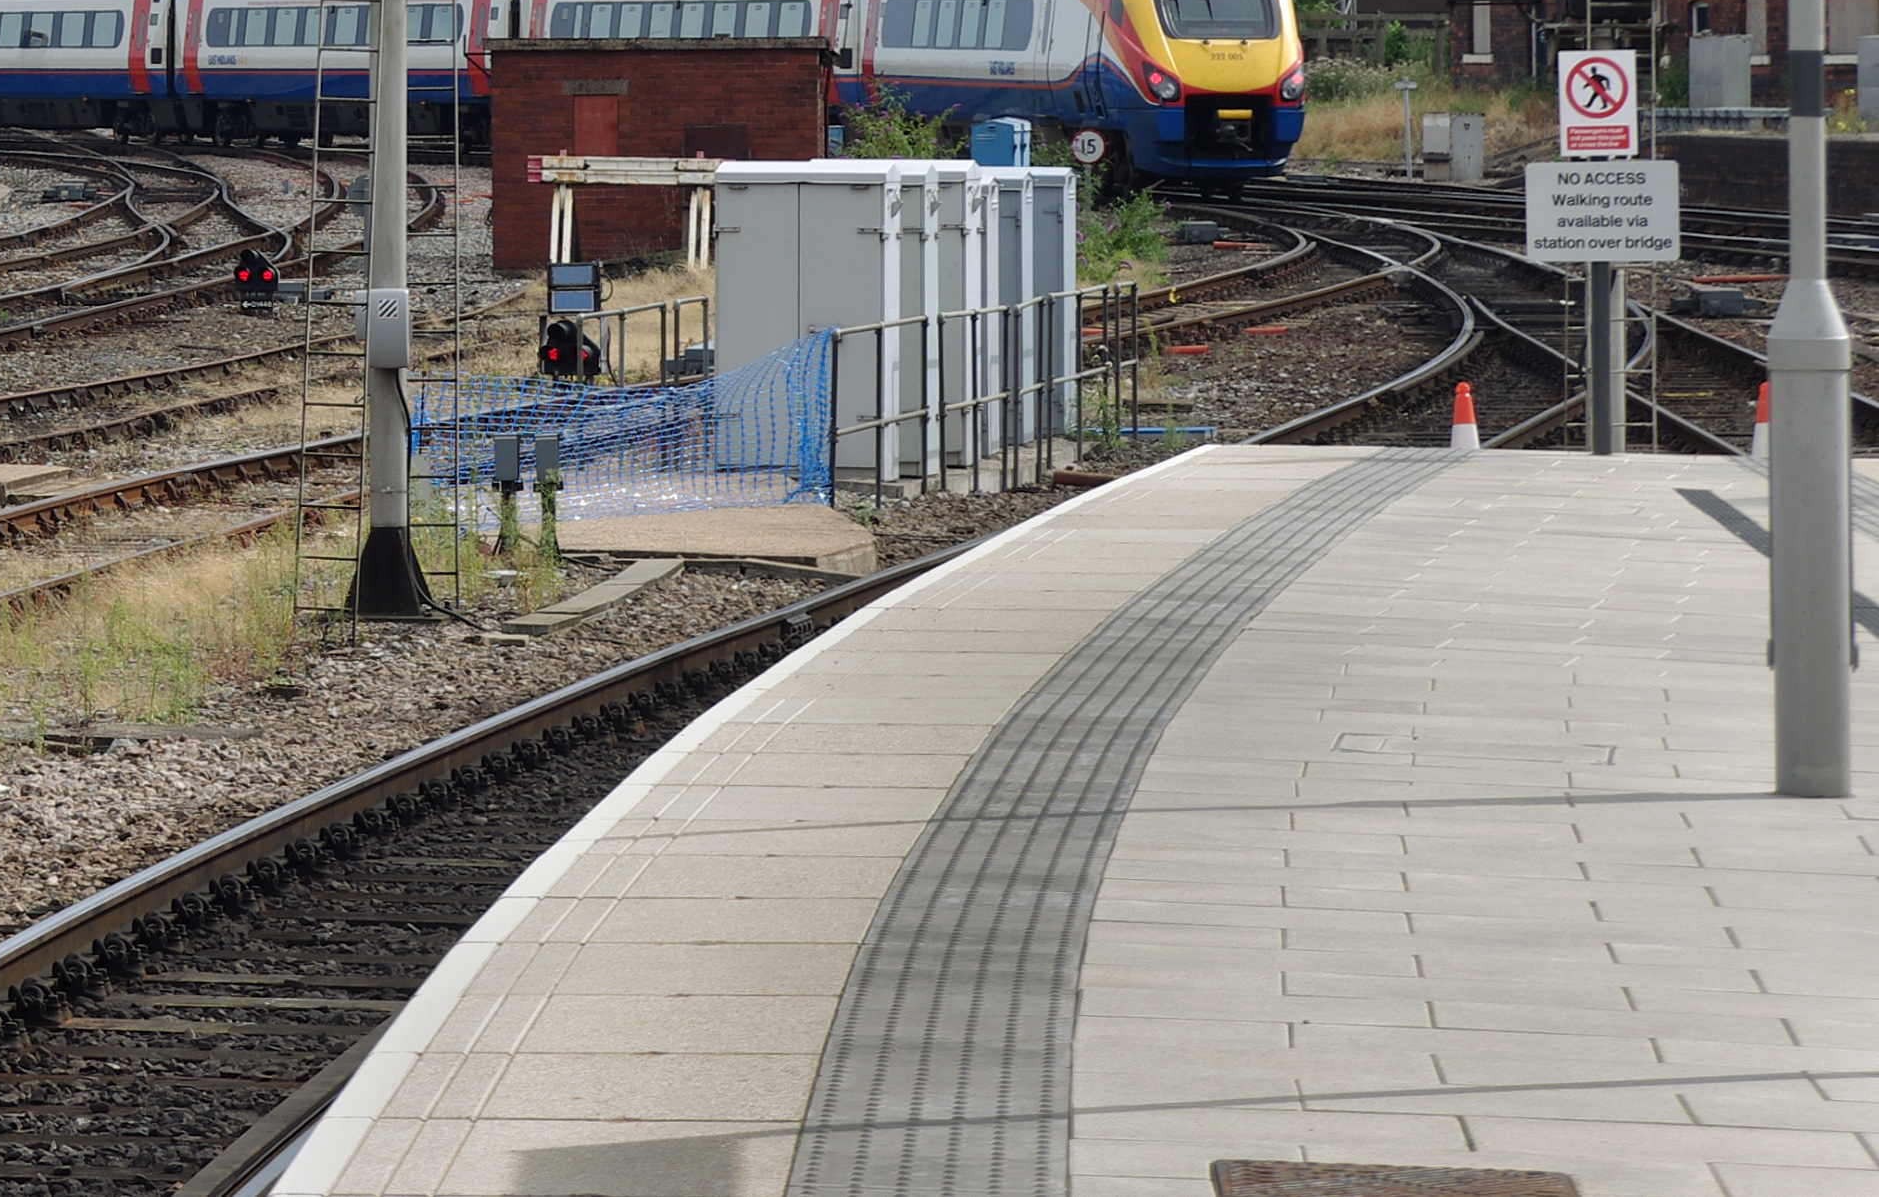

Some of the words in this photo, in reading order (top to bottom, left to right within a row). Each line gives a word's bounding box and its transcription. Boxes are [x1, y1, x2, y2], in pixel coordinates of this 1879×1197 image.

[1081, 139, 1096, 154] 15
[1557, 172, 1581, 185] NO
[1584, 172, 1646, 185] ACCESS
[1552, 194, 1610, 208] Walking
[1613, 194, 1653, 206] route
[1557, 215, 1623, 228] available
[1626, 214, 1648, 227] via
[1534, 236, 1585, 249] station
[1588, 238, 1622, 249] over
[1625, 236, 1672, 251] bridge
